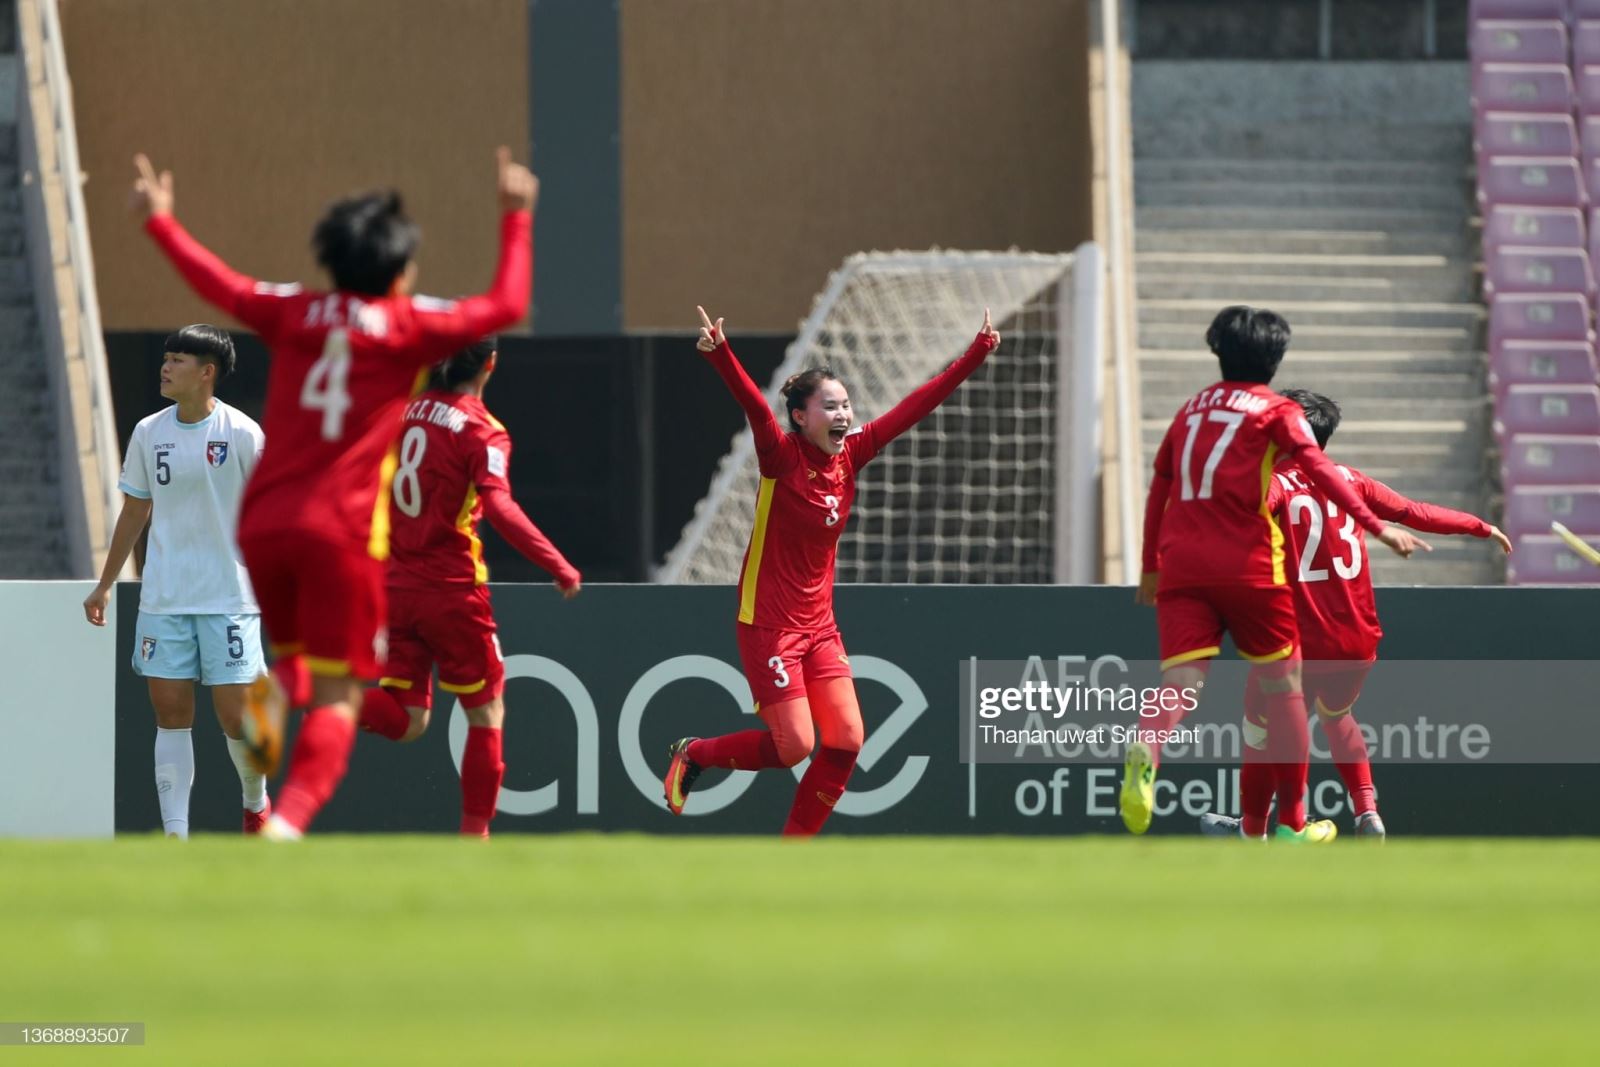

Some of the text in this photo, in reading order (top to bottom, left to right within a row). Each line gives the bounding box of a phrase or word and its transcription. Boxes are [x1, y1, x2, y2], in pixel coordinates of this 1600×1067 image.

[300, 327, 352, 441] 4
[156, 451, 171, 486] 5
[393, 425, 427, 518] 8
[1180, 409, 1246, 501] 17
[825, 495, 839, 527] 3
[1288, 494, 1362, 583] 23
[226, 625, 244, 660] 5
[768, 655, 791, 689] 3
[1015, 654, 1129, 702] AFC
[448, 653, 931, 818] ace
[1014, 711, 1242, 759] Acaem
[1014, 767, 1378, 817] of Ecellc
